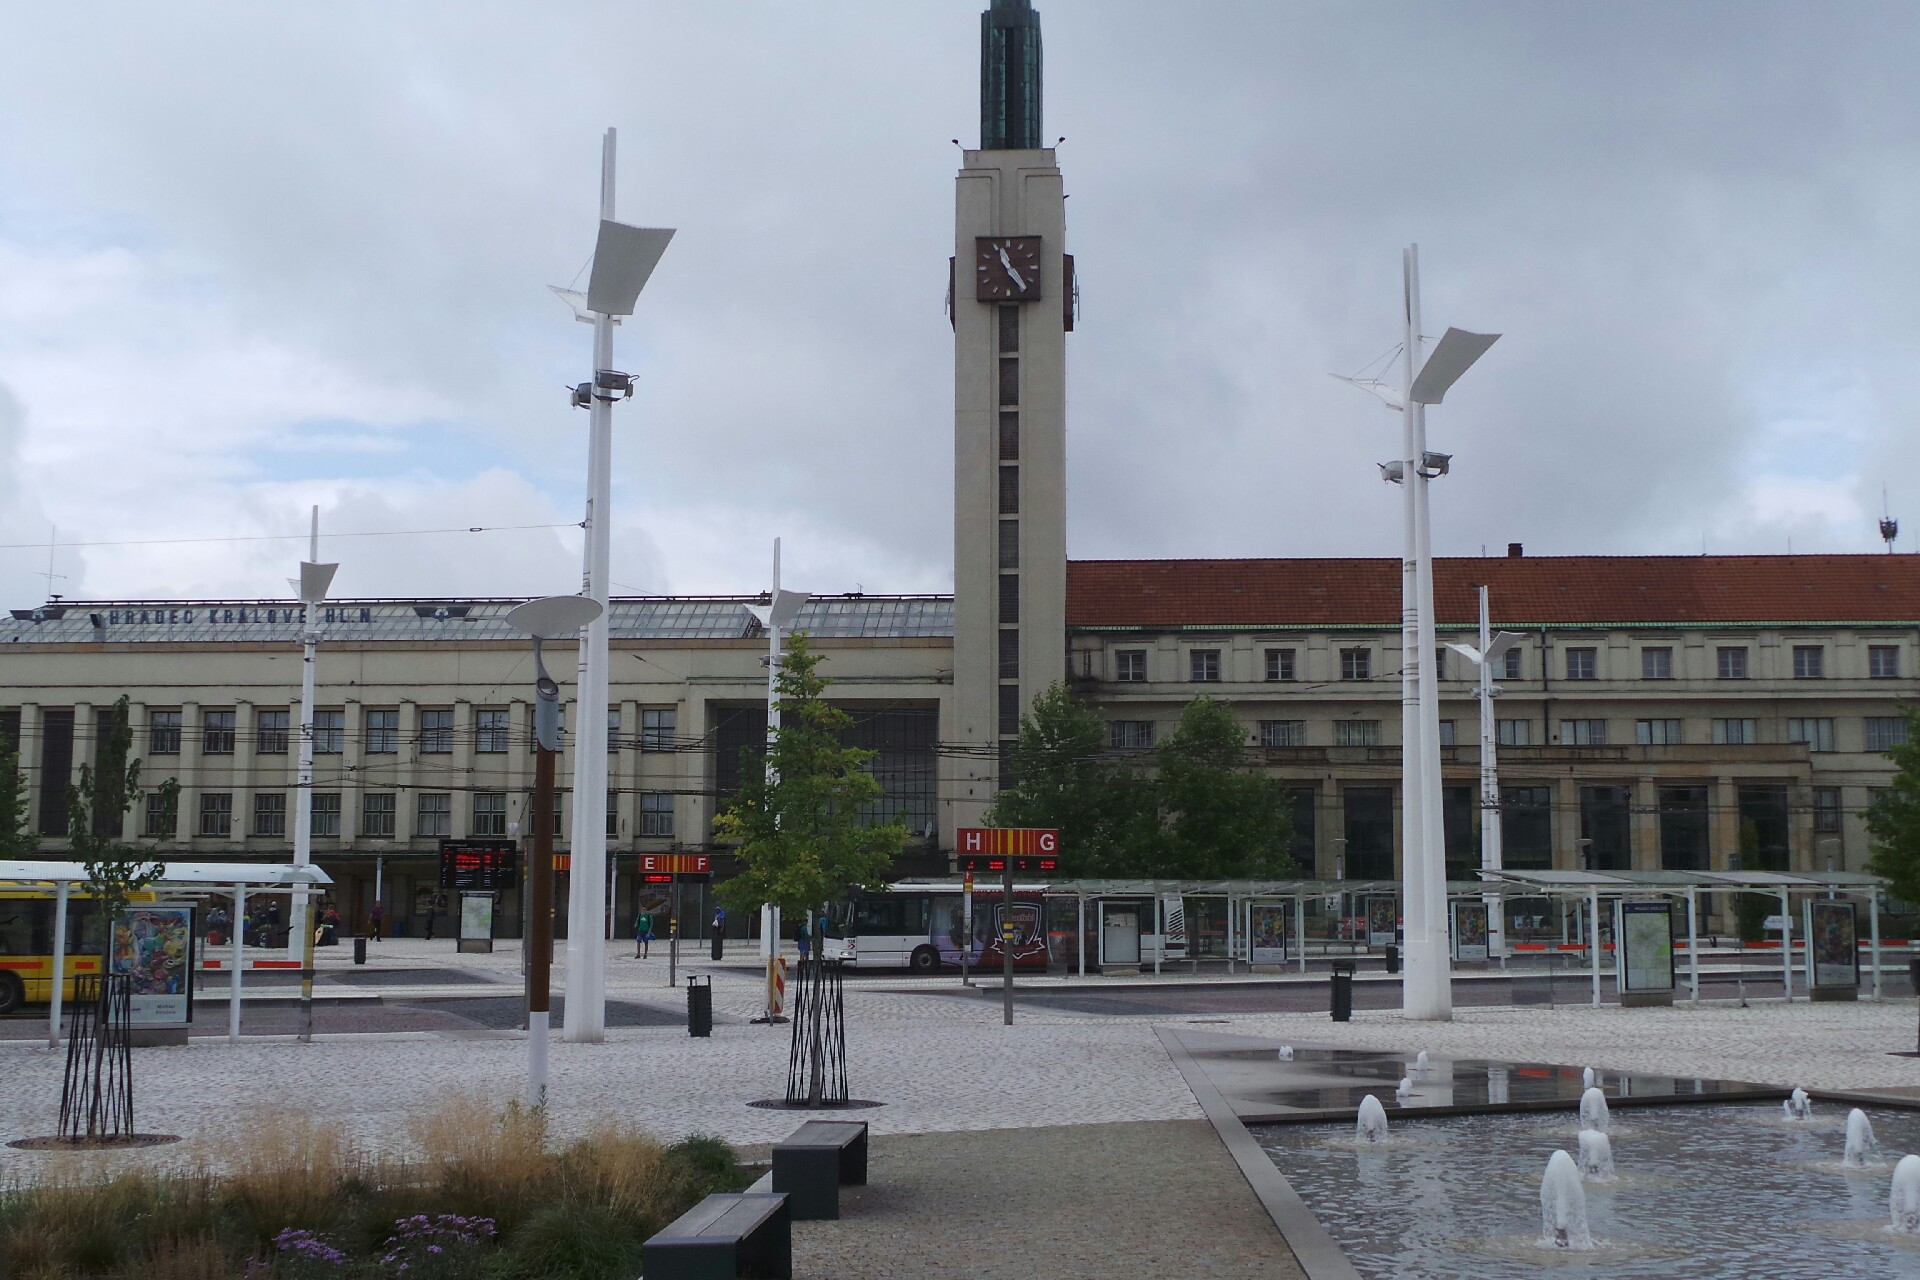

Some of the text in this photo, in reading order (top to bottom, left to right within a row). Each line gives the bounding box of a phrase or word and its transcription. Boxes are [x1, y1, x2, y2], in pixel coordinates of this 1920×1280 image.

[109, 609, 193, 624] HRADEC
[966, 832, 1055, 851] H G
[645, 857, 706, 870] E F
